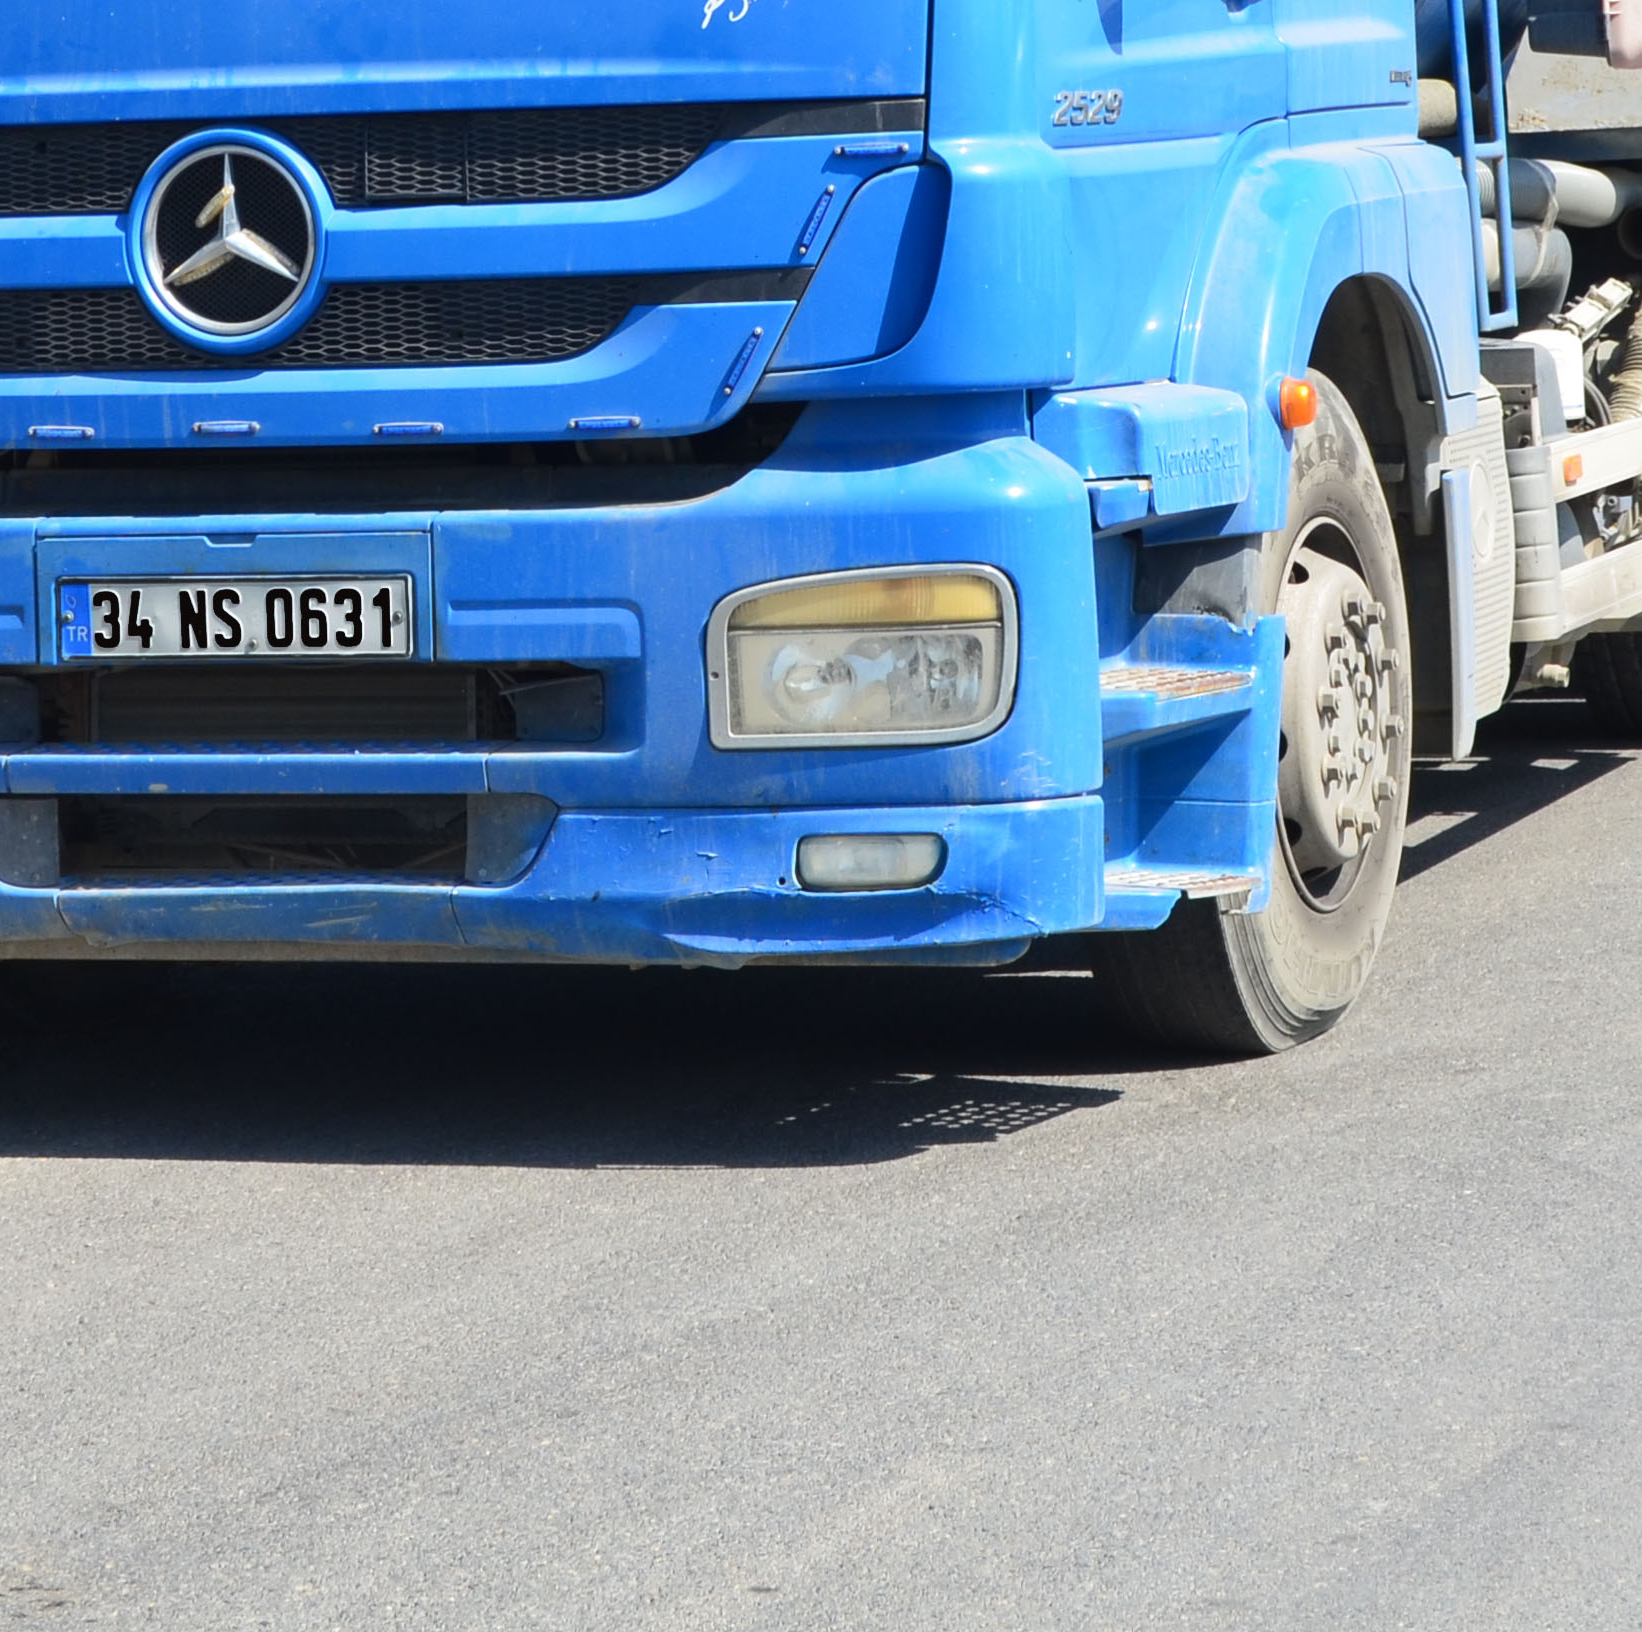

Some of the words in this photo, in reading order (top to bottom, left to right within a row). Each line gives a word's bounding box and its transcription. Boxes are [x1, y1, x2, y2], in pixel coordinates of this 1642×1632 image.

[1052, 89, 1124, 127] 2529
[66, 625, 89, 643] TR
[92, 589, 155, 649] 34
[178, 588, 243, 649] NS
[264, 587, 394, 648] 0631
